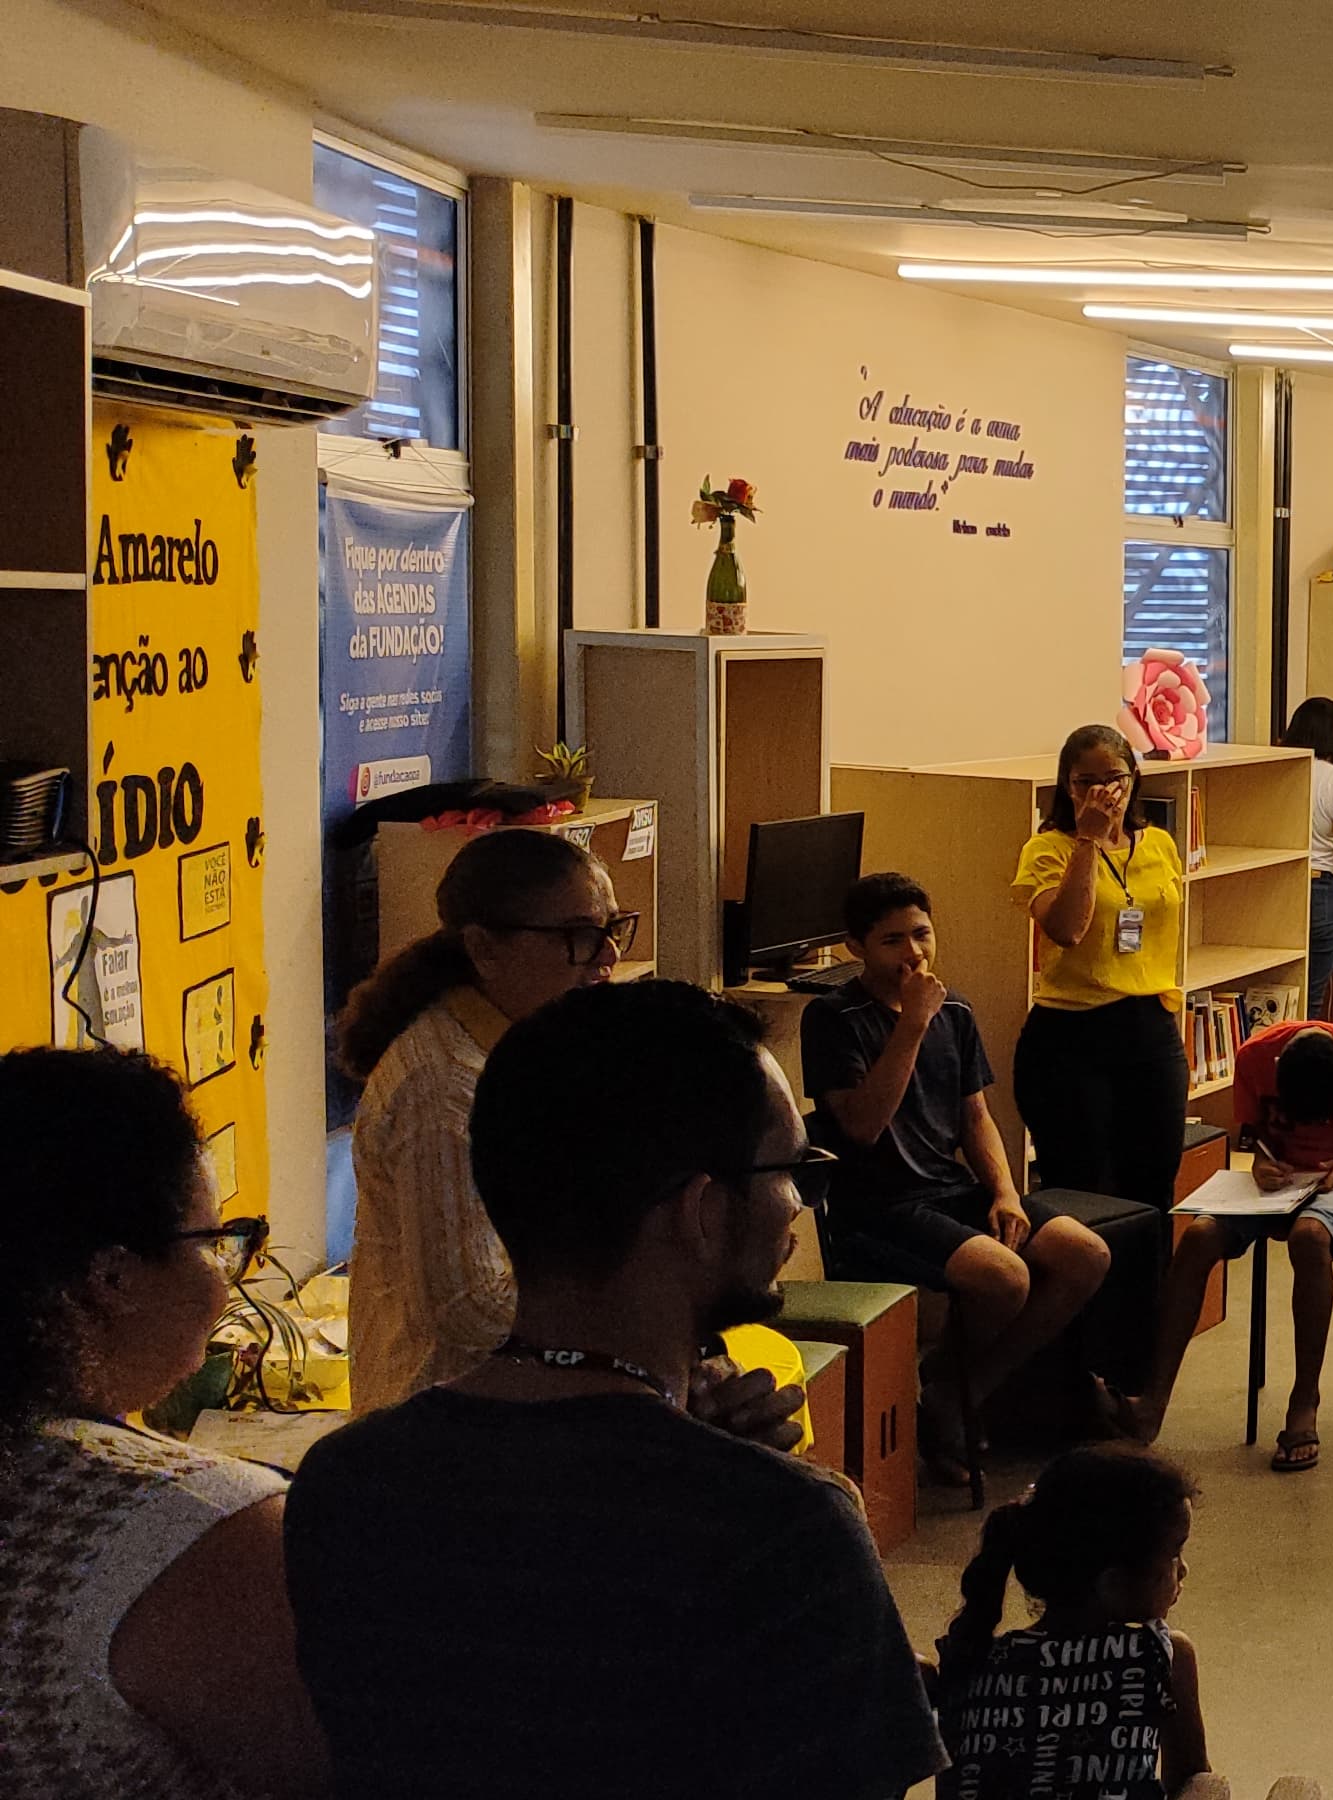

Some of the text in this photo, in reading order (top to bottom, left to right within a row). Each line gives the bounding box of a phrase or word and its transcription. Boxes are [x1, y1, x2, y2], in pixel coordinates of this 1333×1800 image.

[92, 513, 219, 586] Amarelo
[344, 535, 445, 580] Fique por dentro
[354, 581, 437, 615] das AGENDAS
[349, 618, 445, 665] da FUNDAÇÃO!
[178, 646, 209, 694] ao
[204, 869, 226, 890] NÃO
[102, 949, 129, 977] Falar
[544, 1350, 585, 1366] FCP
[966, 1671, 1034, 1700] HINE
[1118, 1666, 1147, 1721] GIRL
